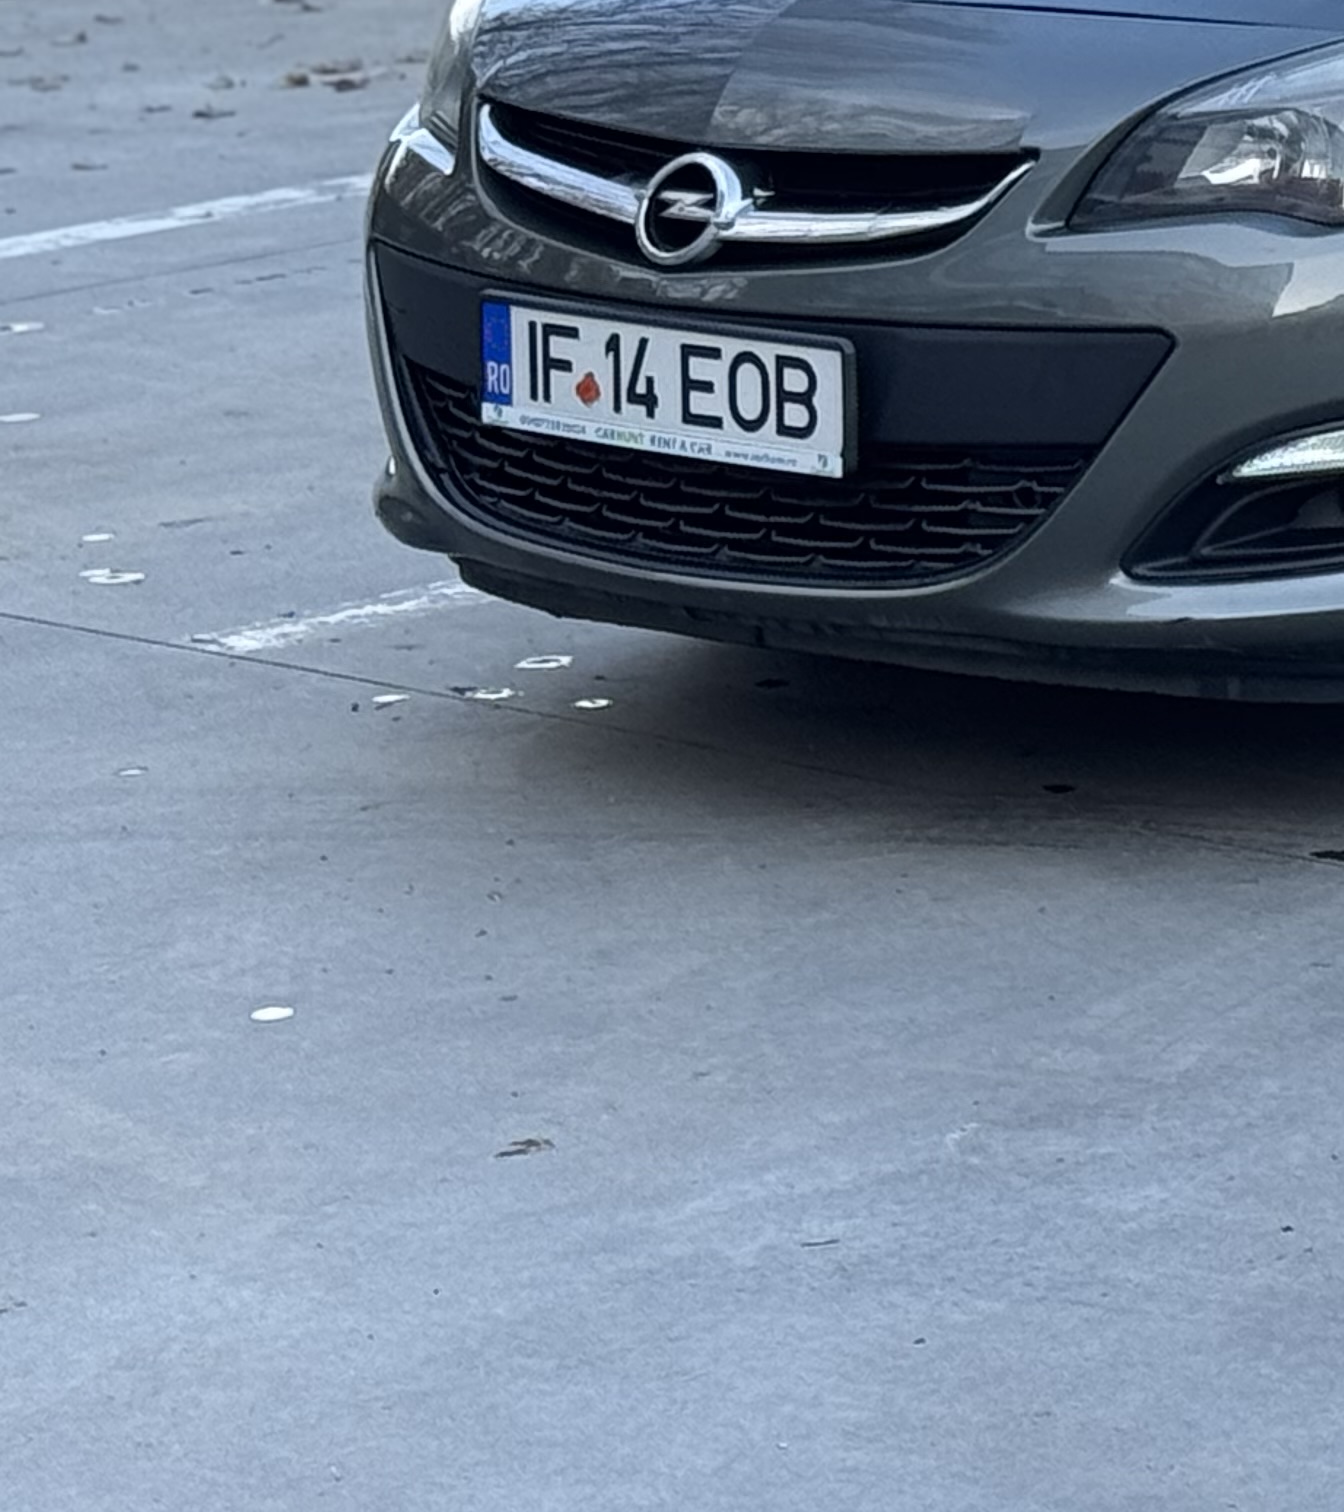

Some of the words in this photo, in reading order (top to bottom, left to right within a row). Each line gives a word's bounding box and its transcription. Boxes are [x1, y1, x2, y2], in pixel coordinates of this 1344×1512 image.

[488, 361, 512, 395] RO
[527, 320, 580, 405] IF
[605, 332, 659, 420] 14
[680, 343, 819, 440] EOB
